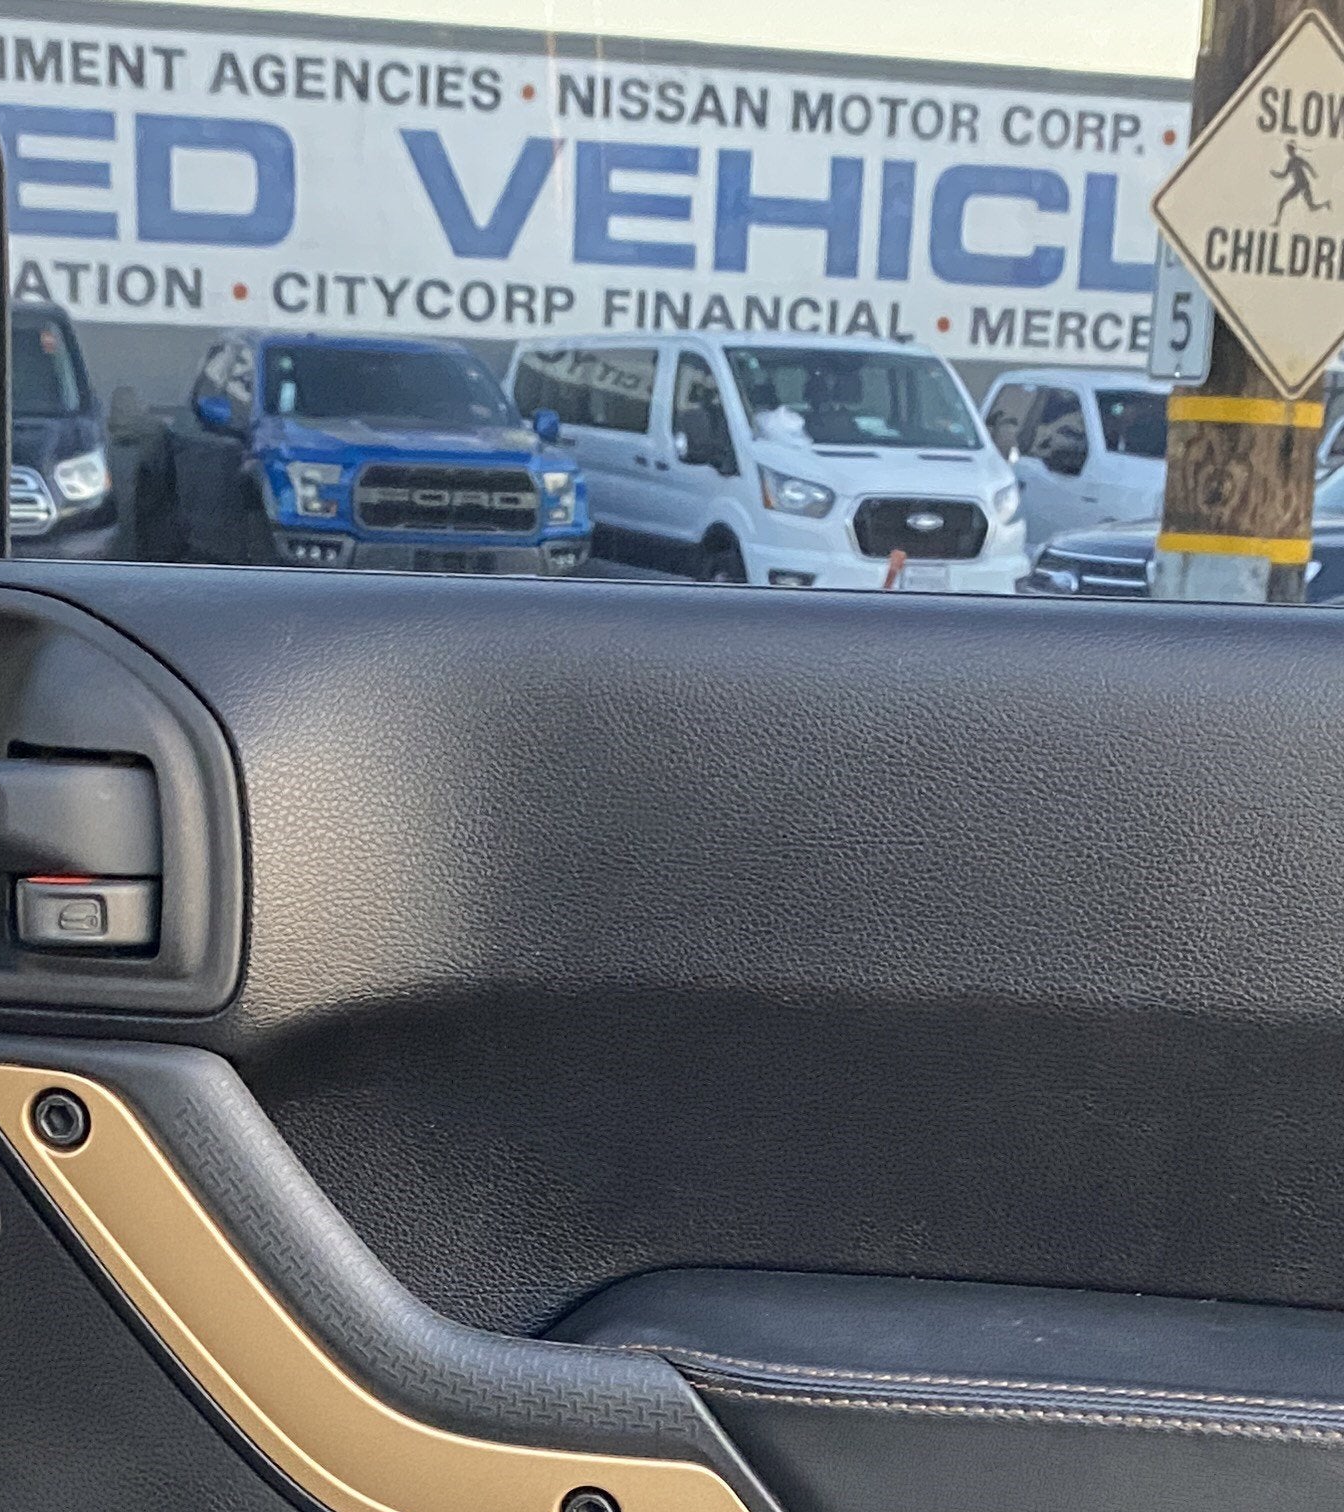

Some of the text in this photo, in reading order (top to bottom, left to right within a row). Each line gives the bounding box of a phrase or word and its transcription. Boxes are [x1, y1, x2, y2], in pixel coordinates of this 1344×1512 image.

[209, 50, 503, 112] AGENCIES
[557, 73, 769, 131] NISSAN
[790, 90, 979, 144] MOTOR
[1001, 106, 1146, 155] CORP.
[12, 259, 204, 309] ATION
[271, 269, 574, 326] CITYCORP
[603, 286, 916, 344] FINANCIAL
[968, 305, 1152, 354] MERCE
[1169, 291, 1193, 352] 5
